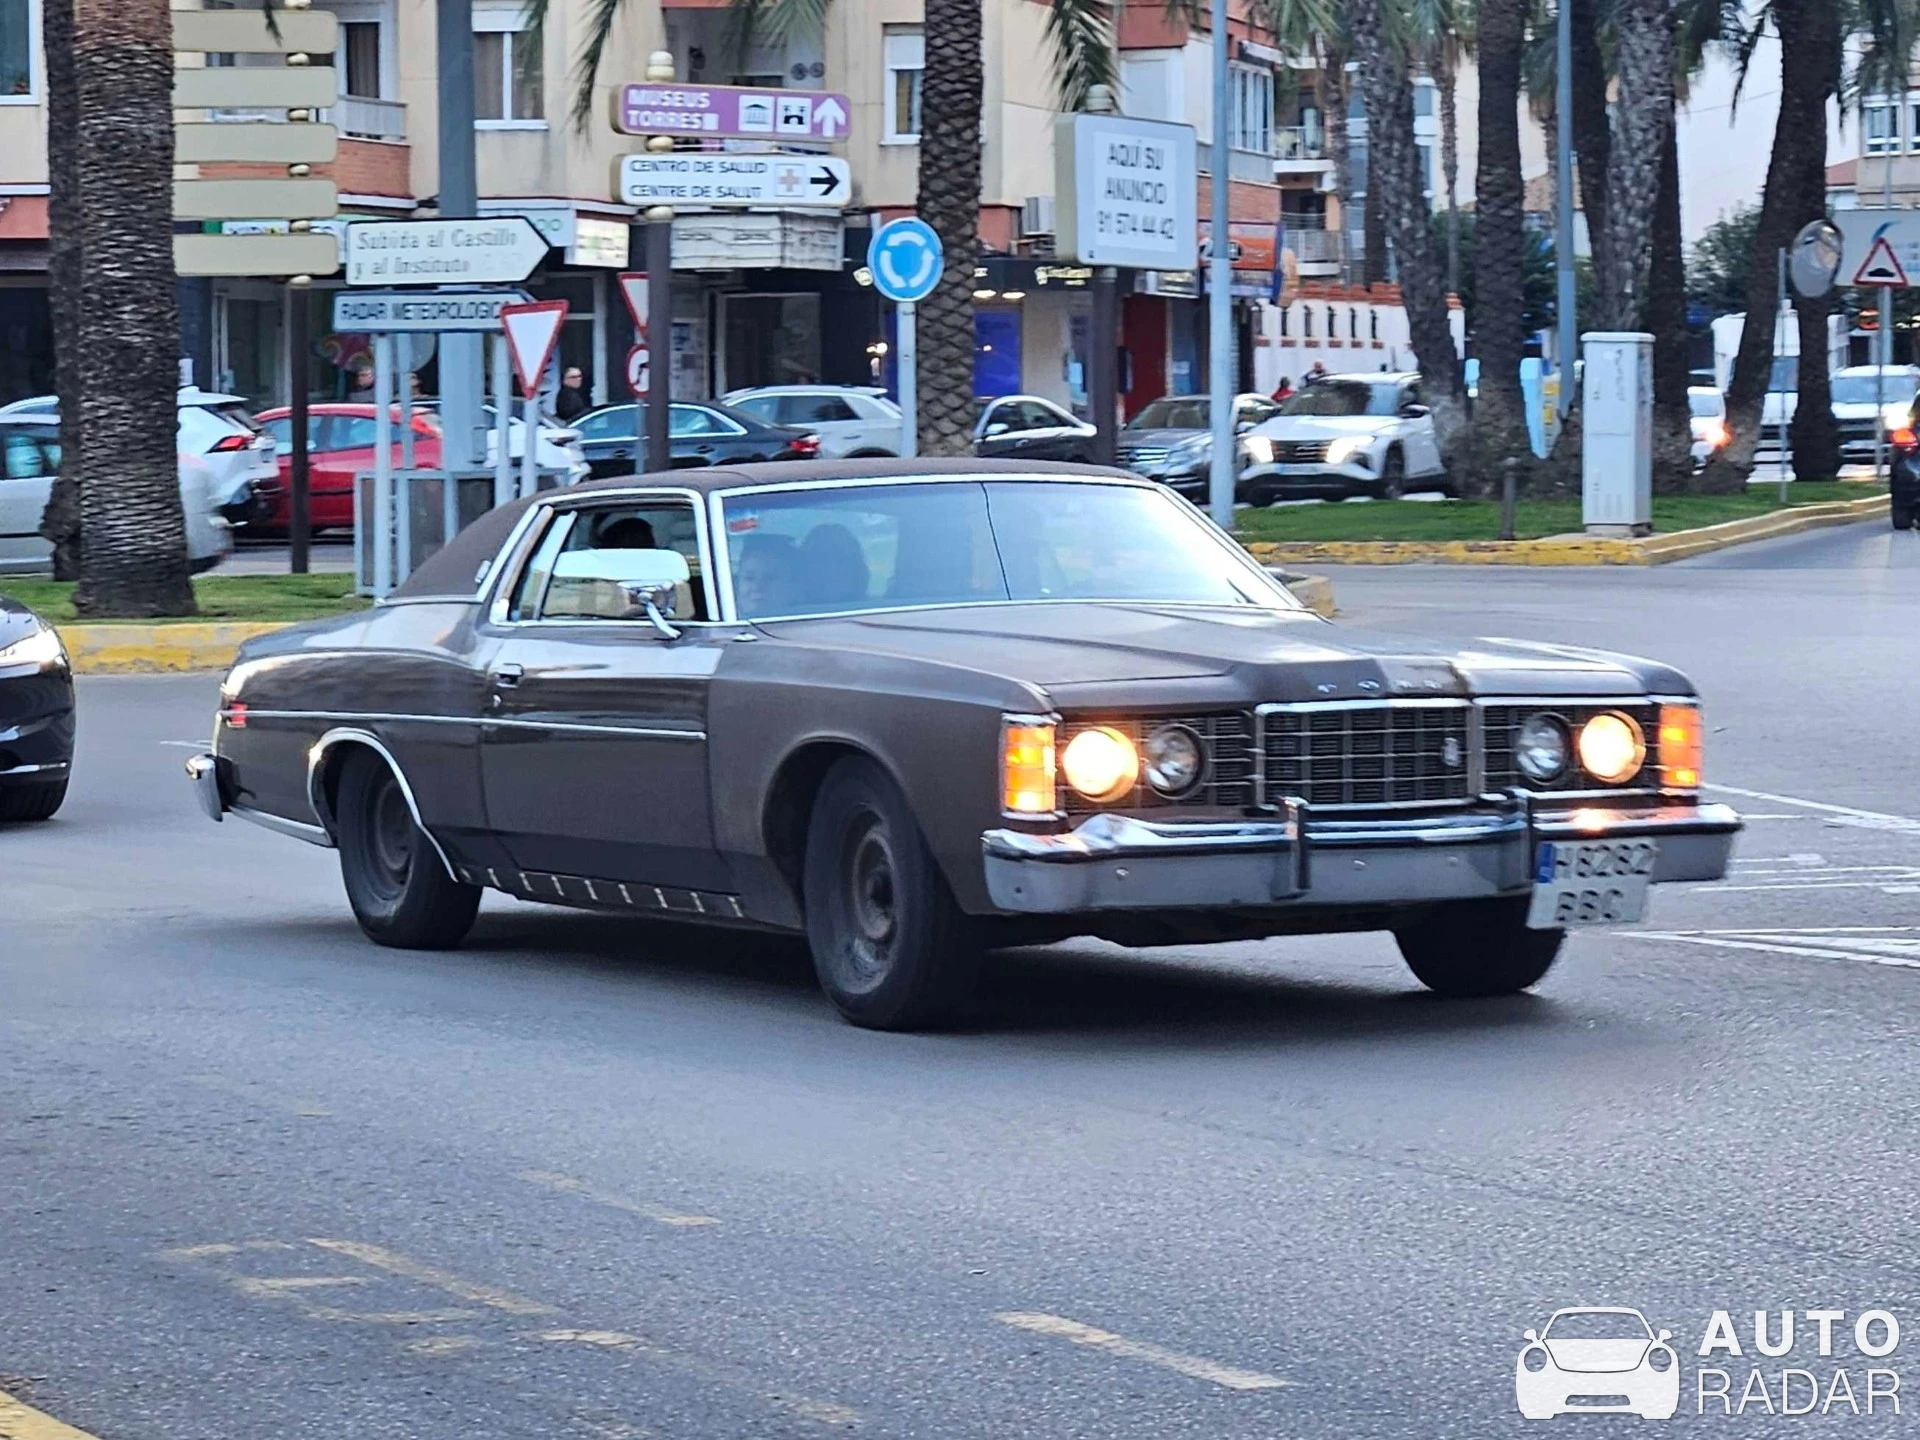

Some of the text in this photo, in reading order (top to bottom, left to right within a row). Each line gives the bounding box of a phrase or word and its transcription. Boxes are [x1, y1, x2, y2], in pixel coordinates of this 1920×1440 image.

[627, 89, 711, 108] MUSEUS
[627, 110, 703, 129] TORRES
[629, 160, 768, 174] CENTRO DE SALUD
[1144, 146, 1164, 170] SU
[629, 184, 762, 199] CENTRE DE SALUT
[1104, 178, 1167, 204] ANUNCIO
[356, 227, 518, 250] Subida al Castillo
[354, 260, 365, 280] y
[371, 257, 388, 275] al
[393, 254, 471, 275] Instituto
[340, 301, 510, 321] RADAR METEOROLOGIC
